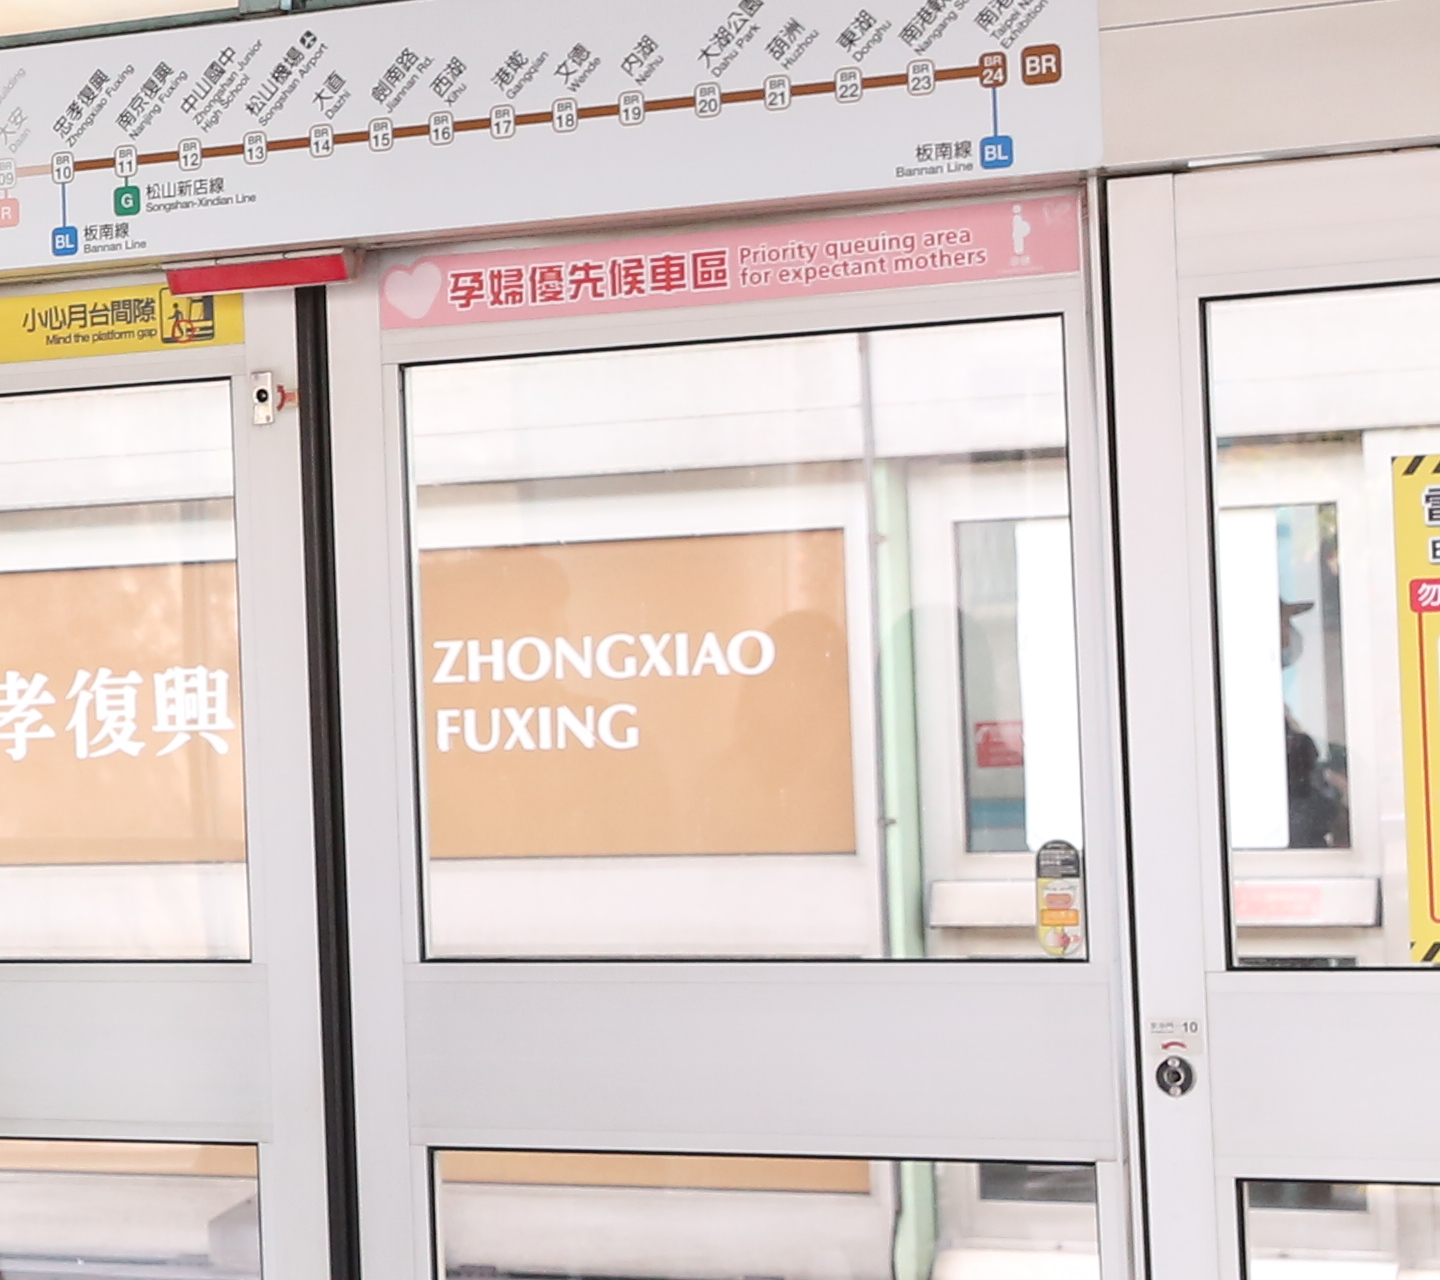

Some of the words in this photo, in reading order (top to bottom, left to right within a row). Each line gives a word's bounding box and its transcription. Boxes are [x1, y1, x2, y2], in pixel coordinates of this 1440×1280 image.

[835, 9, 878, 53] 東湖
[852, 20, 892, 63] Donghu
[237, 38, 263, 72] Junior
[711, 48, 739, 78] Dahu
[737, 23, 761, 50] Park
[780, 29, 820, 70] Huzhou
[299, 43, 329, 79] Airport
[553, 42, 591, 85] 文德
[634, 55, 665, 86] Neihu
[1026, 55, 1056, 75] BR
[180, 47, 236, 114] 中山國中
[245, 46, 305, 117] 松山機場
[429, 56, 467, 98] 西湖
[567, 57, 601, 93] Wende
[911, 76, 931, 91] 23
[982, 68, 1003, 84] 24
[115, 61, 174, 131] 南京復興
[312, 70, 347, 112] 大直
[385, 73, 420, 114] Jiannan
[444, 83, 468, 107] Xihu
[768, 92, 786, 106] 21
[839, 84, 859, 98] 22
[52, 69, 111, 139] 忠孝復興
[65, 96, 108, 148] Zhongxiao
[107, 64, 135, 98] Fuxing
[129, 104, 161, 141] Nanjing
[159, 71, 188, 104] Fuxing
[200, 108, 223, 133] High
[220, 73, 251, 110] School
[324, 90, 352, 120] Dazhi
[623, 107, 641, 121] 19
[698, 99, 717, 113] 20
[494, 121, 512, 134] 17
[557, 114, 574, 128] 18
[373, 133, 390, 147] 15
[433, 127, 451, 140] 16
[248, 147, 264, 160] 13
[313, 140, 330, 153] 14
[916, 140, 973, 162] 板南線
[984, 144, 1008, 161] BL
[118, 160, 133, 173] 11
[182, 154, 199, 167] 12
[896, 164, 943, 178] Bannan
[947, 162, 973, 173] Line
[55, 168, 71, 180] 10
[146, 178, 224, 200] 松山新店線
[235, 193, 257, 203] Line
[120, 193, 134, 208] G
[1, 207, 11, 219] R
[55, 235, 75, 249] BL
[84, 222, 129, 241] 板南線
[84, 243, 123, 253] Bannan
[125, 240, 147, 250] Line
[739, 242, 817, 264] Priority
[825, 233, 916, 260] queuing
[923, 228, 971, 247] area
[739, 268, 771, 286] for
[778, 258, 887, 285] expectant
[894, 249, 987, 273] mothers
[449, 249, 729, 310] 孕婦優先候車區
[23, 297, 156, 333] 小心月台間隙
[46, 334, 72, 345] Mind
[74, 333, 90, 343] the
[92, 330, 135, 343] platform
[138, 328, 157, 339] gap
[431, 629, 777, 687] ZHONGXIAO
[434, 702, 640, 754] FUXING
[1183, 1022, 1198, 1032] 10
